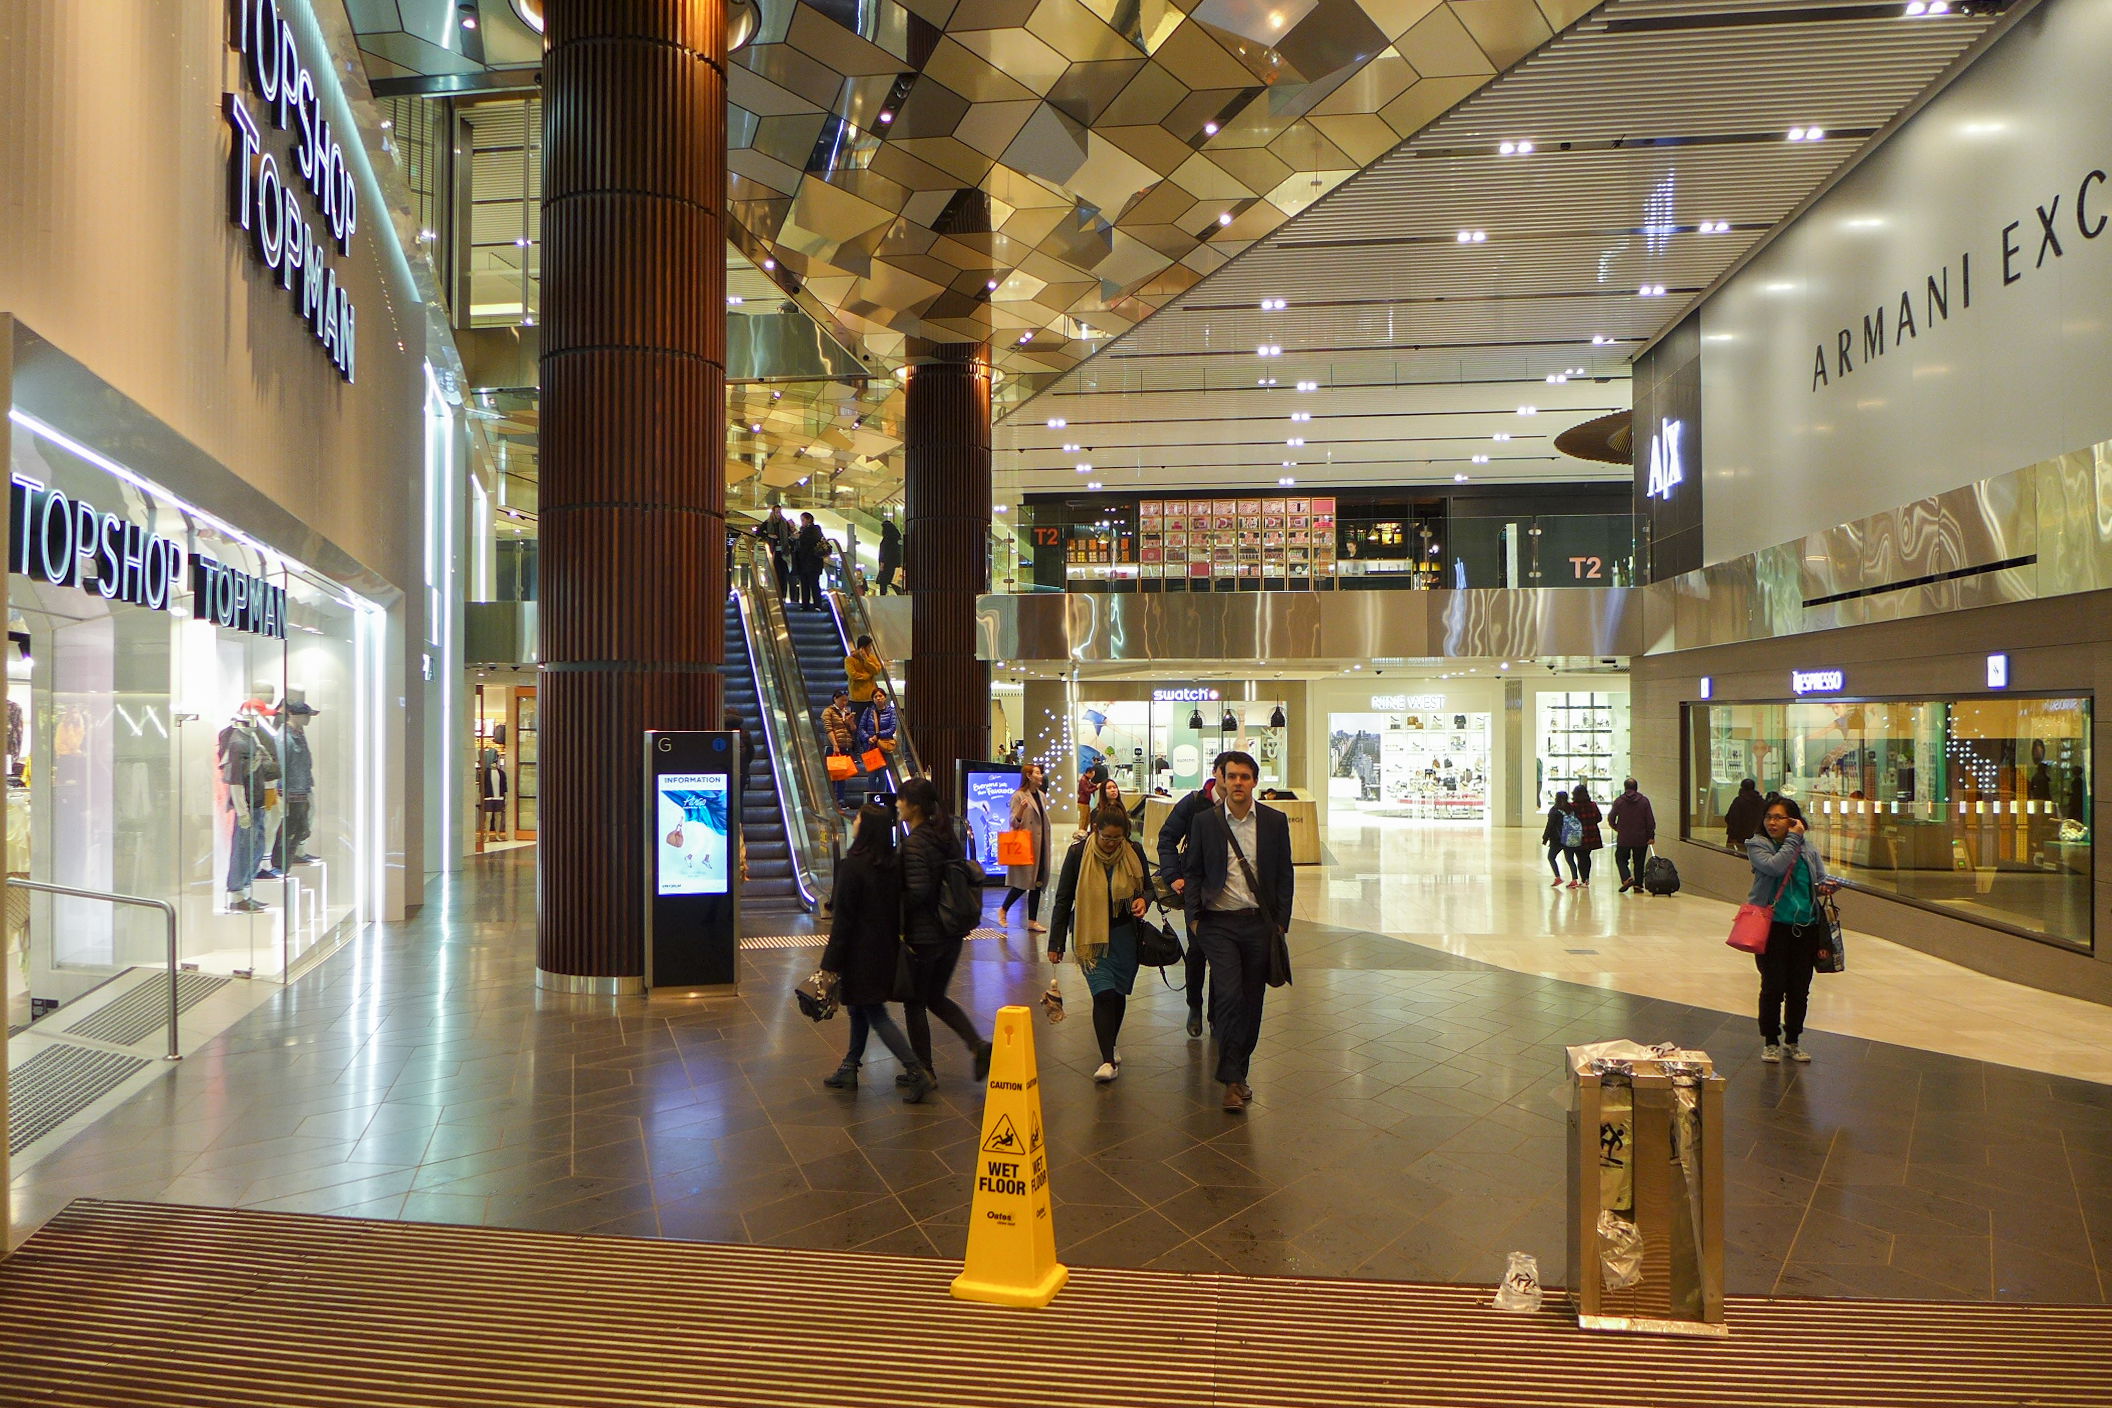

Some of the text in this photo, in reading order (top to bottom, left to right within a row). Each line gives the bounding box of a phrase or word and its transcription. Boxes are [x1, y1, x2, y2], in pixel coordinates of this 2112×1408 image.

[222, 92, 355, 384] TOPMAN
[1812, 169, 2108, 393] ARMANI EXC
[1035, 528, 1059, 546] T2
[9, 472, 288, 641] TOPSHOP TOPMAN
[1569, 557, 1602, 579] T2
[1791, 670, 1844, 695] NESPRESSO
[1153, 688, 1207, 701] swatch
[1371, 694, 1445, 710] NINE WEST
[658, 737, 672, 752] G
[664, 776, 721, 784] INFORMATION
[874, 795, 881, 803] G
[1003, 842, 1023, 855] T2
[990, 1080, 1022, 1091] CAUTION
[988, 1161, 1019, 1179] WET
[979, 1177, 1026, 1196] FLOOR
